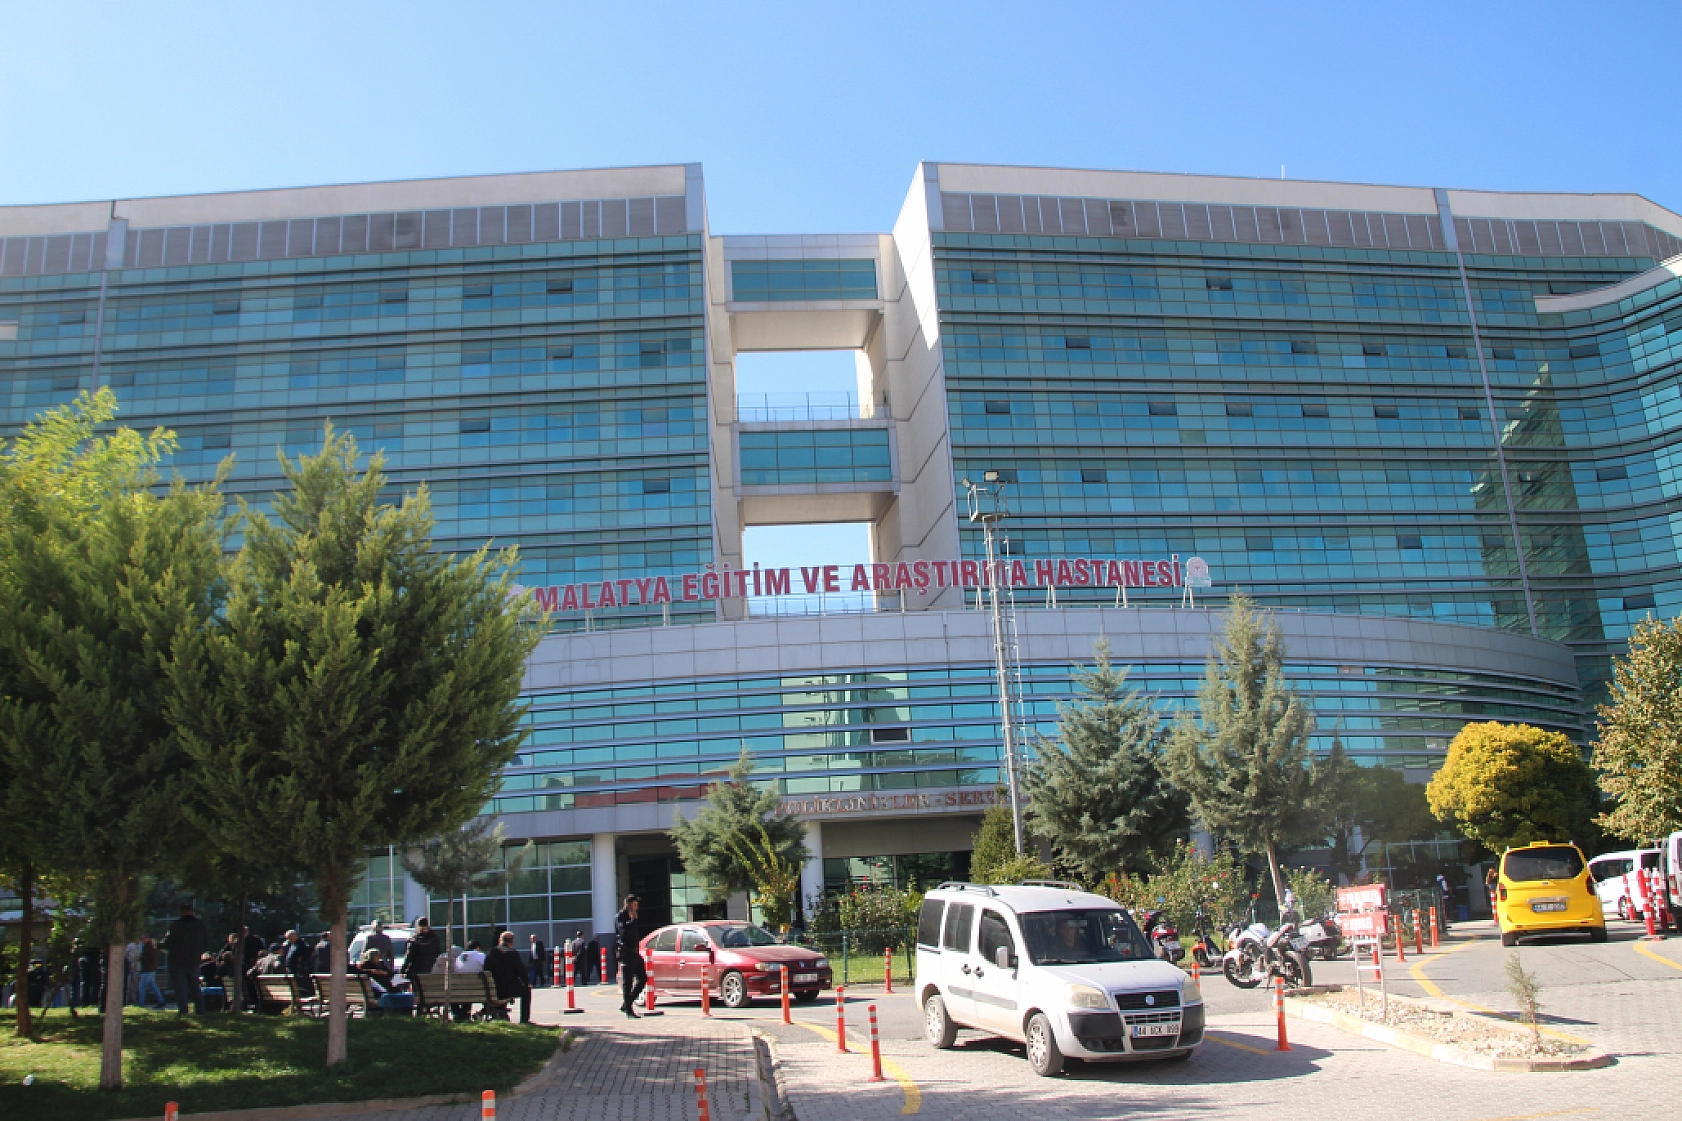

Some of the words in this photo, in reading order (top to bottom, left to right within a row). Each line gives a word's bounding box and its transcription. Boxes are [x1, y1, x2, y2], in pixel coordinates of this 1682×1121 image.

[535, 576, 671, 612] MALATYA
[682, 562, 791, 601] EĞİTİM
[801, 565, 840, 594] VE
[1036, 553, 1182, 587] HASTANESİ
